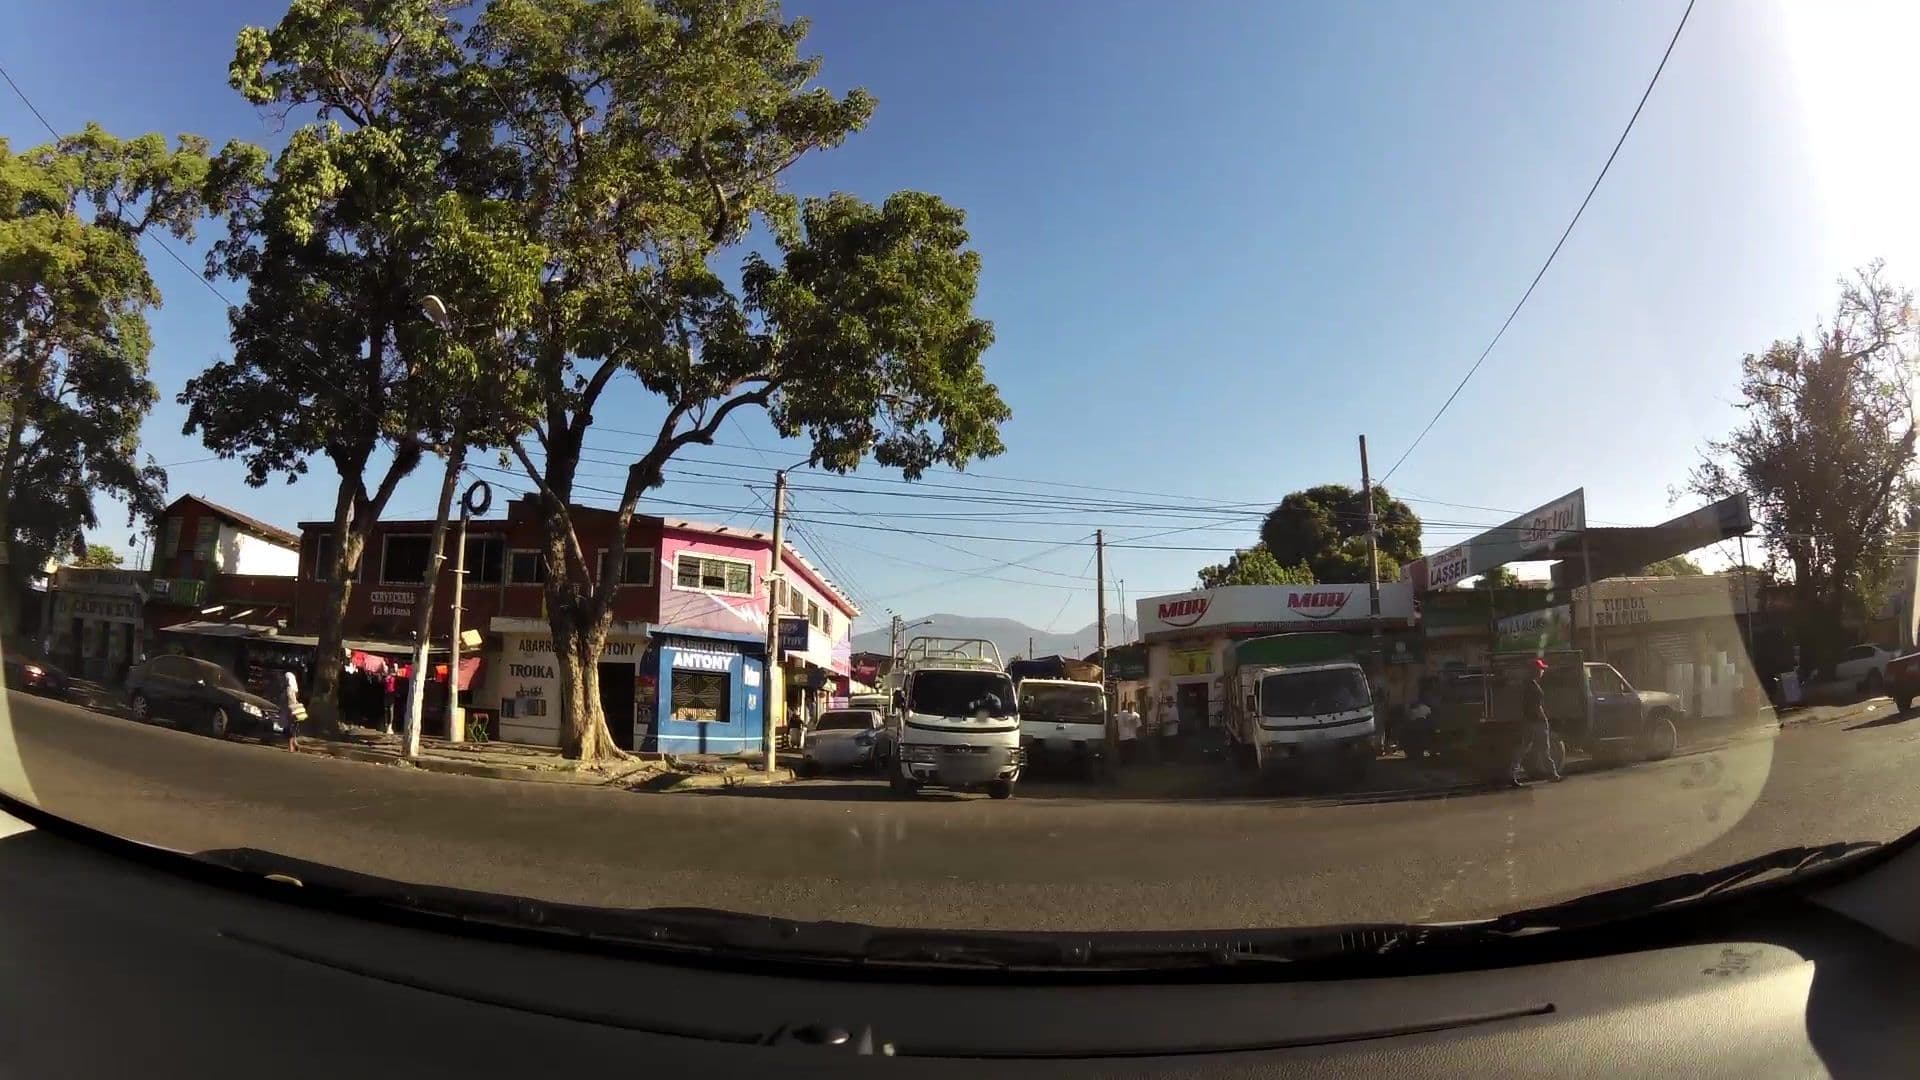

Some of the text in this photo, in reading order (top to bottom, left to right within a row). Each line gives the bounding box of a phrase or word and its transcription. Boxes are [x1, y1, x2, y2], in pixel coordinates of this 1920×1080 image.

[1430, 558, 1468, 586] LASSER
[602, 643, 635, 656] TONY
[672, 652, 733, 671] ANTONY
[509, 663, 554, 679] TROIKA
